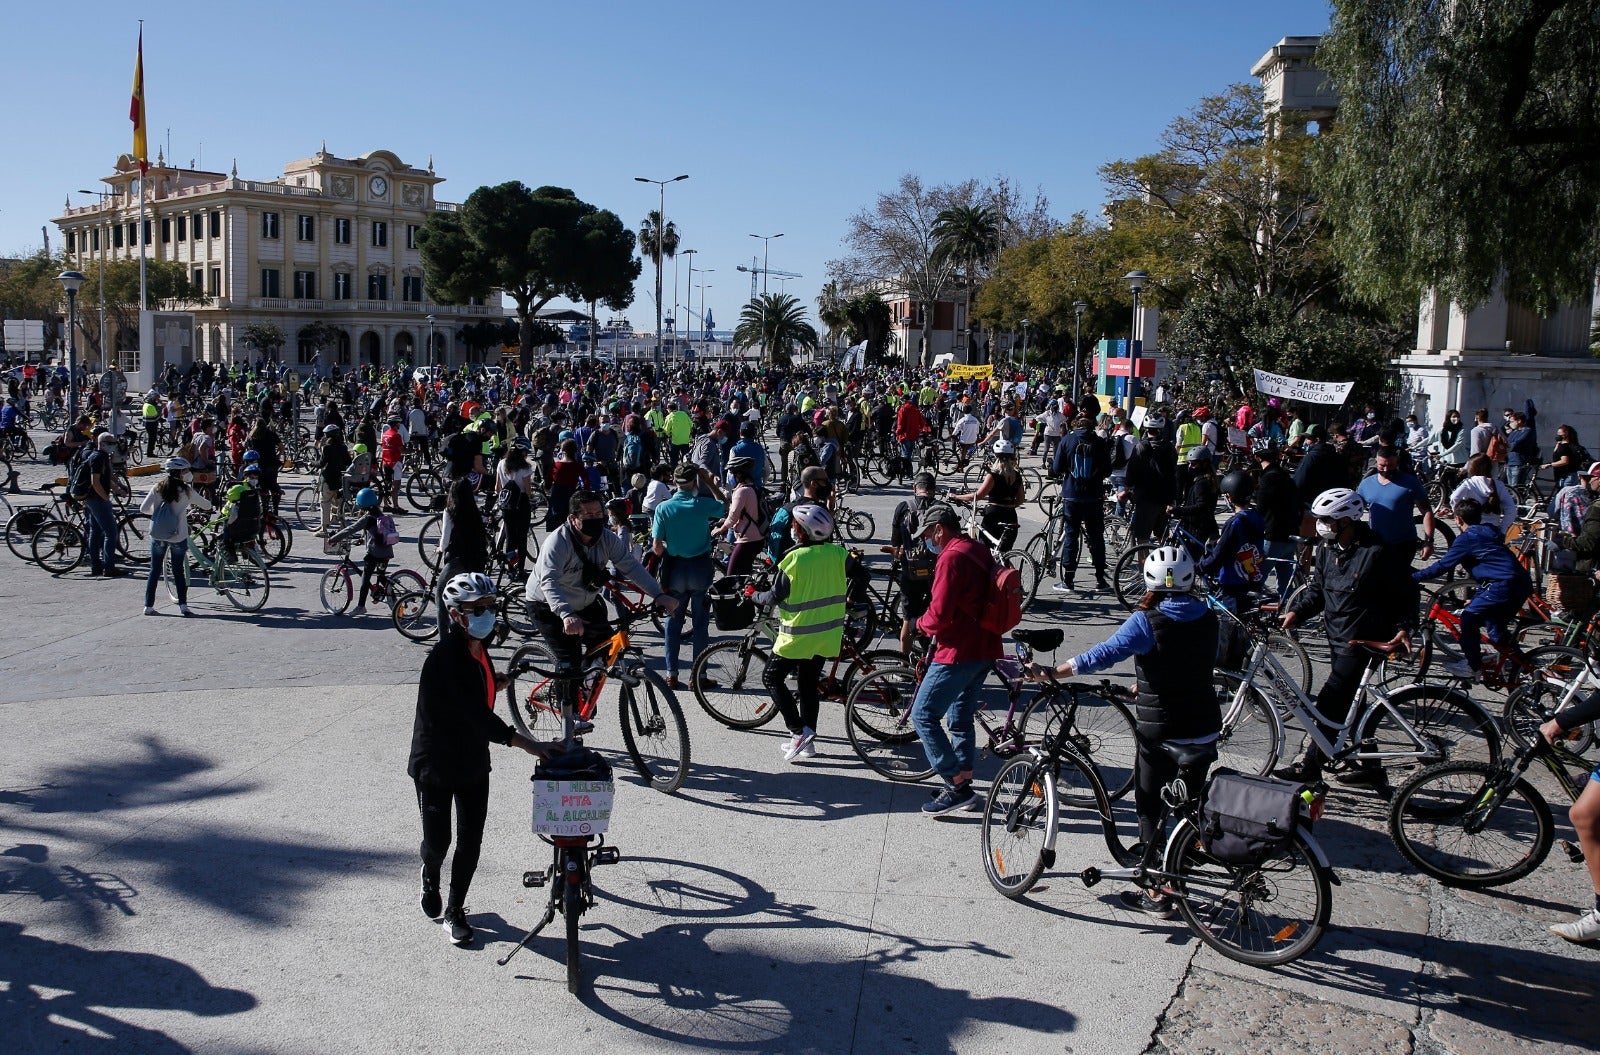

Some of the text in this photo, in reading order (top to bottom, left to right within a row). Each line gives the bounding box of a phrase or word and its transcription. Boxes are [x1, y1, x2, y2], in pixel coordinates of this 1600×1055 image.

[1260, 373, 1346, 393] SOMOS PARTE DE
[1270, 385, 1280, 394] LA
[547, 782, 614, 792] SI MOLESTO
[561, 795, 592, 806] PITA
[546, 809, 610, 821] AL ALCALDE
